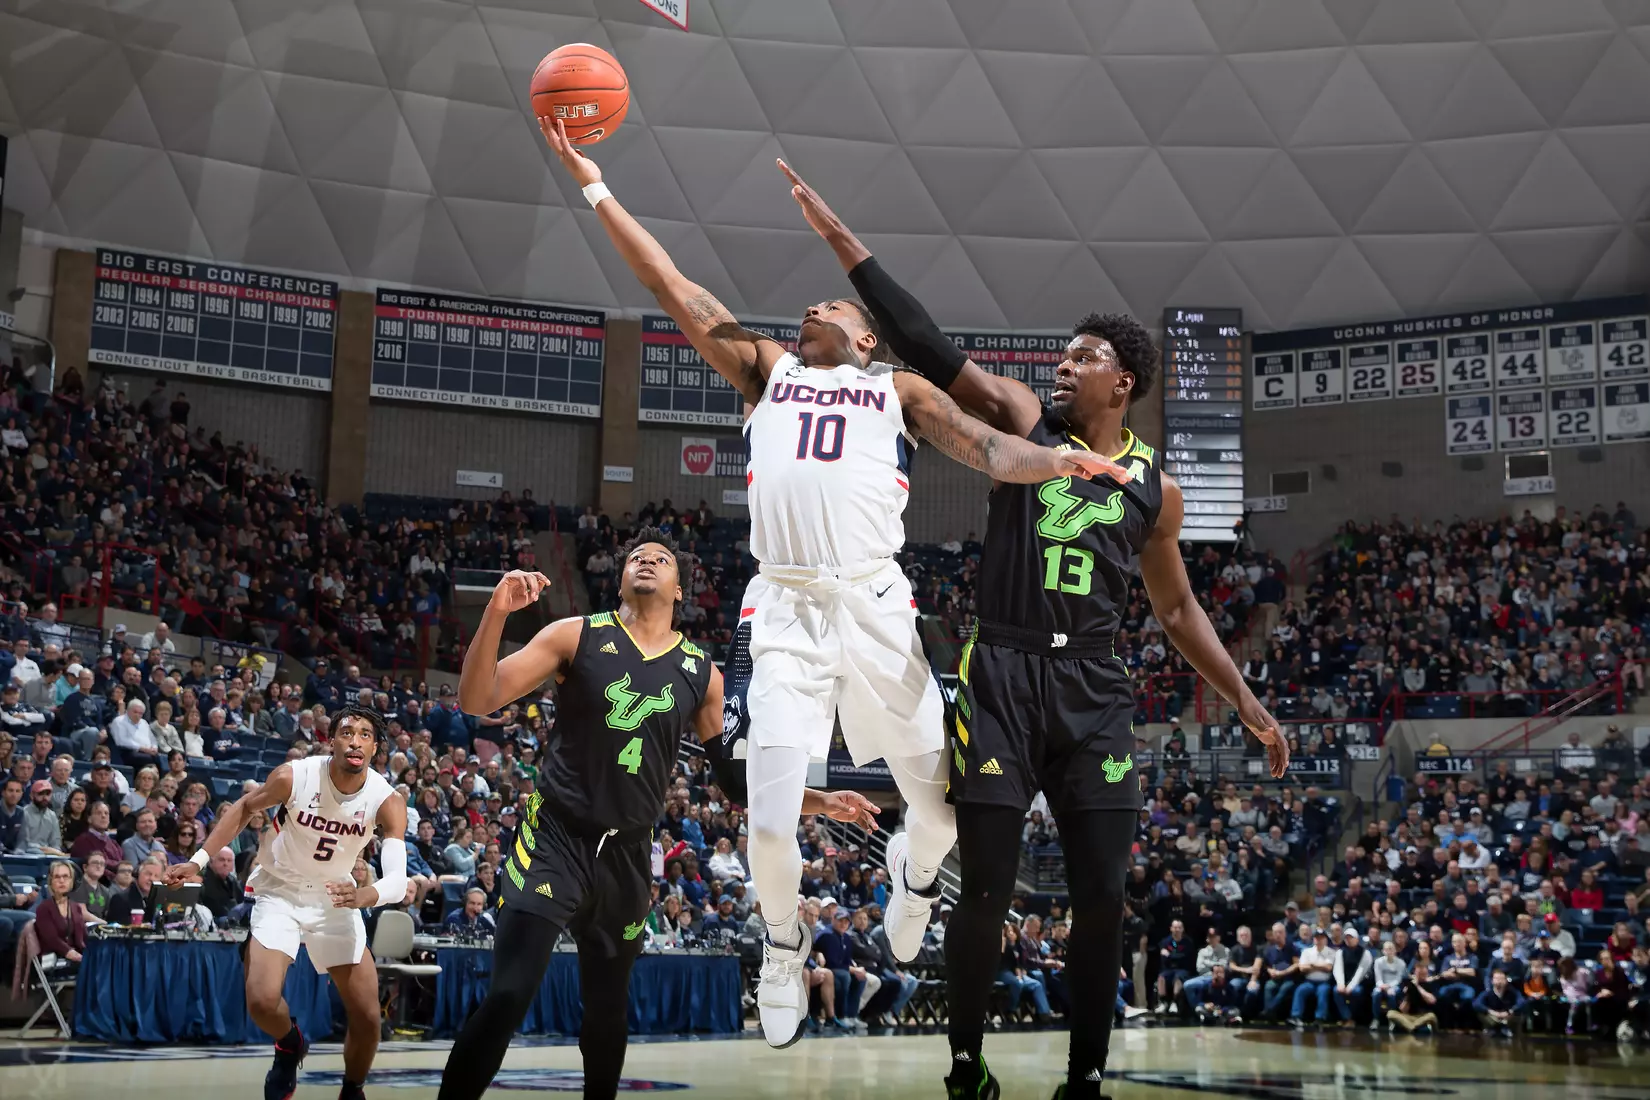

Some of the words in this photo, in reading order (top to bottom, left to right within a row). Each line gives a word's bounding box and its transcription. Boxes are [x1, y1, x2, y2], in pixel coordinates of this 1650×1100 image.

[102, 252, 135, 269] BIG
[146, 261, 196, 277] EAST
[207, 268, 332, 296] CONFERENCE
[101, 269, 171, 287] REGULAR
[179, 279, 238, 295] SEASON
[245, 288, 331, 309] CHAMPIONS
[135, 287, 160, 306] 1994
[170, 292, 195, 310] 1995
[205, 296, 230, 315] 1996
[274, 306, 298, 325] 1999
[305, 311, 332, 329] 2002
[381, 293, 398, 304] BIG
[400, 296, 425, 307] EAST
[429, 298, 436, 307] &
[440, 300, 488, 314] AMERICAN
[492, 305, 537, 319] ATHLETIC
[539, 310, 600, 324] CONFERENCE
[96, 306, 125, 325] 2003
[131, 311, 160, 330] 2005
[167, 316, 195, 334] 2006
[398, 308, 494, 327] TOURNAMENT
[501, 319, 583, 337] CHAMPIONS
[1334, 326, 1386, 340] UCONN
[1394, 318, 1462, 333] HUSKIES
[1471, 314, 1489, 326] OF
[1499, 308, 1554, 322] HONOR
[377, 342, 402, 360] 2016
[413, 323, 437, 340] 1996
[479, 330, 502, 347] 1999
[510, 333, 536, 350] 2002
[542, 337, 568, 353] 2004
[575, 341, 599, 357] 2011
[646, 346, 669, 362] 1955
[678, 348, 701, 364] 1974
[966, 351, 1008, 361] MENT
[1502, 353, 1537, 376] 44
[1608, 343, 1645, 366] 42
[96, 352, 189, 372] CONNECTICUT
[196, 365, 236, 378] MEN'S
[242, 371, 325, 389] BASKETBALL
[645, 369, 668, 385] 1989
[677, 370, 701, 386] 1993
[1003, 364, 1026, 380] 1957
[1353, 367, 1386, 390] 22
[1401, 363, 1436, 386] 25
[1452, 358, 1486, 381] 42
[1264, 377, 1284, 398] C
[1315, 373, 1327, 393] 9
[377, 387, 464, 403] CONNECTICUT
[515, 401, 594, 415] BASKETBALL
[770, 382, 886, 413] UCONN
[645, 411, 730, 424] CONNECTICUT
[1507, 416, 1535, 437] 13
[1557, 411, 1590, 435] 22
[796, 412, 847, 462] 10
[1453, 419, 1487, 443] 24
[688, 452, 709, 464] NIT
[458, 474, 473, 482] SEC
[489, 475, 497, 485] 4
[605, 469, 632, 478] SOUTH
[1528, 480, 1552, 492] 214
[1264, 498, 1286, 510] 213
[1043, 545, 1094, 596] 13
[618, 737, 643, 775] 4
[1314, 759, 1340, 772] 113
[1420, 760, 1438, 770] SEC
[1445, 758, 1474, 772] 114
[979, 767, 1003, 776] adidas
[296, 811, 366, 837] UCONN
[313, 837, 338, 861] 5
